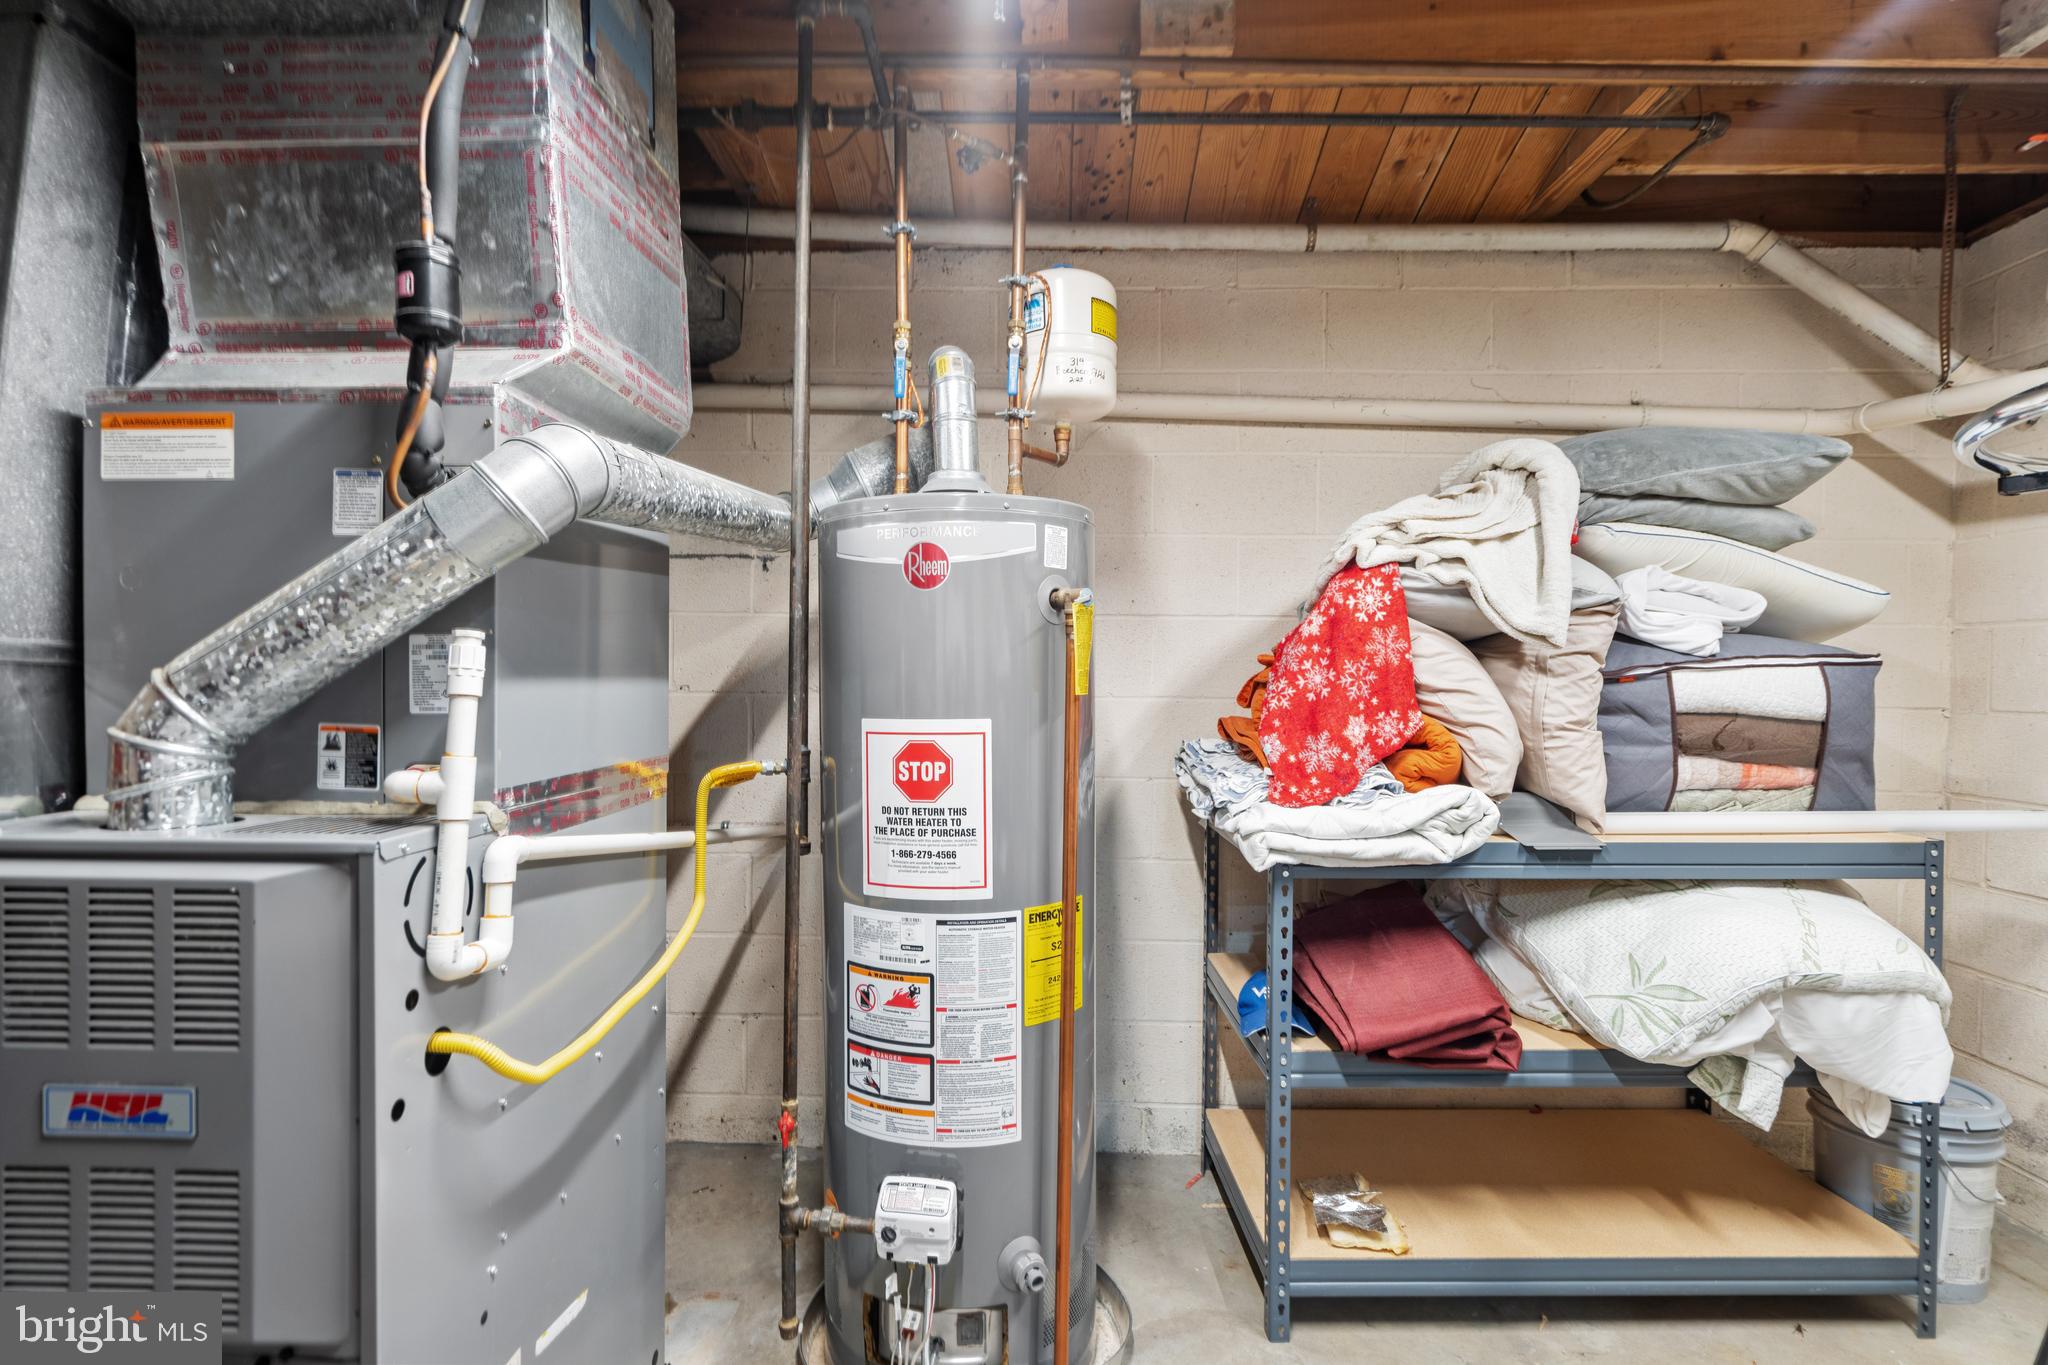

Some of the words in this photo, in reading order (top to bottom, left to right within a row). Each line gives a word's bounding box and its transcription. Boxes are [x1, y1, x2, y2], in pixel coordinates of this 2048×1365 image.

[907, 543, 947, 583] Rheem
[898, 760, 947, 782] STOP
[881, 806, 892, 815] DO
[894, 806, 909, 816] NOT
[911, 807, 945, 816] RETURN
[947, 807, 968, 816] THIS
[886, 816, 913, 826] WATER
[915, 817, 948, 827] HEATER
[950, 817, 962, 827] TO
[874, 826, 888, 836] THE
[890, 827, 915, 837] PLACE
[917, 828, 929, 837] OF
[931, 828, 977, 837] PURCHASE
[890, 849, 957, 859] 1-866-279-4566
[874, 972, 905, 982] WARNING
[876, 1050, 902, 1062] DANGER
